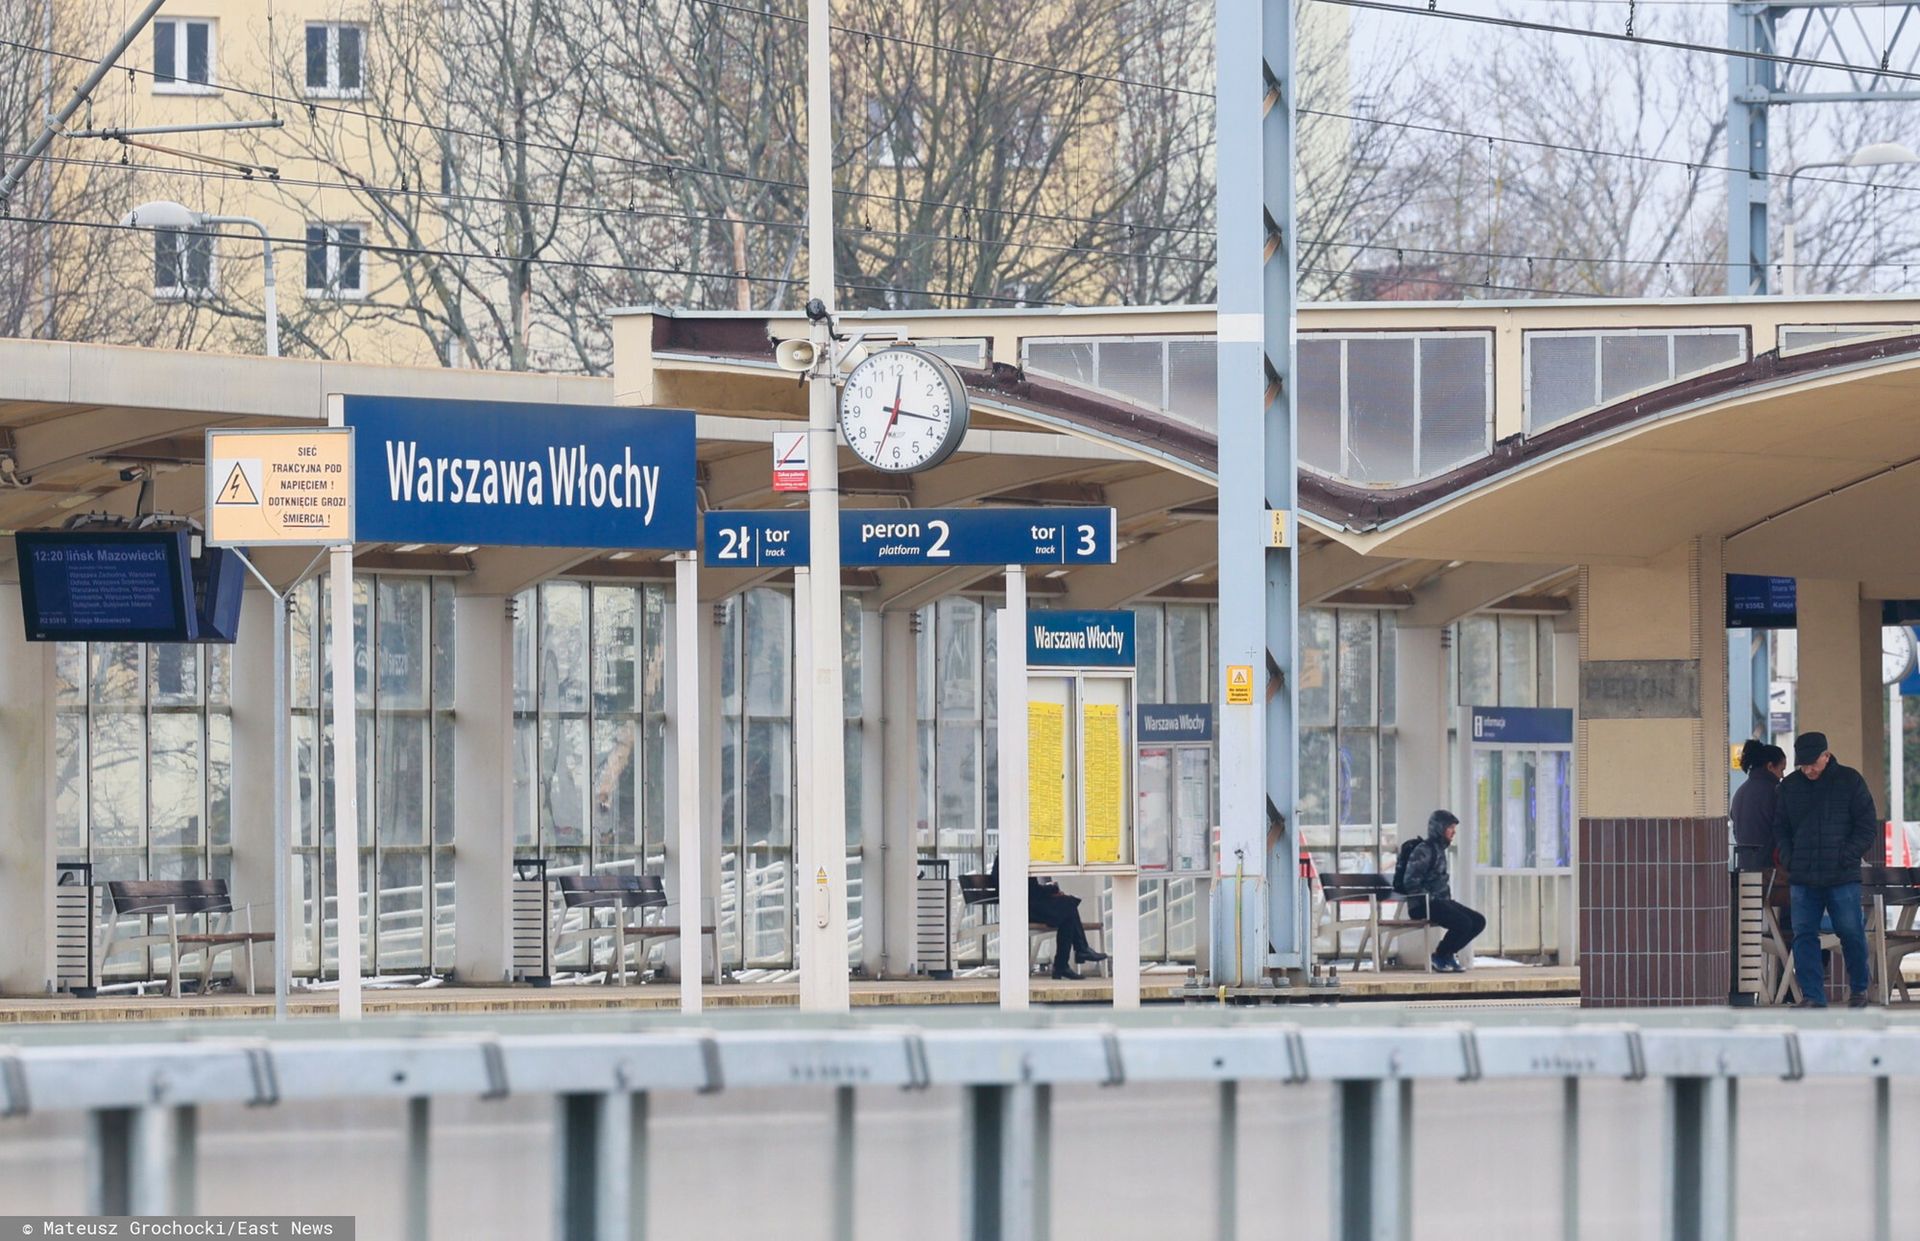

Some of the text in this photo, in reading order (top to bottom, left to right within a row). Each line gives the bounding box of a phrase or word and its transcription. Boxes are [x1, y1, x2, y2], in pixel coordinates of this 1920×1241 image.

[890, 364, 904, 376] 12
[873, 371, 884, 382] 11
[859, 386, 873, 398] 10
[926, 384, 934, 396] 2
[853, 406, 861, 417] 9
[932, 405, 940, 417] 3
[860, 426, 867, 439] 8
[926, 426, 934, 438] 4
[298, 445, 317, 456] SIEĆ
[874, 441, 882, 453] 7
[893, 447, 900, 459] 6
[912, 441, 920, 453] 5
[272, 463, 342, 473] TRAKCYJNA POD
[281, 480, 327, 491] NAPIĘCIEM
[386, 440, 660, 526] Warszawa Włochy
[268, 497, 346, 508] DOTKNIĘCIE GROZI
[718, 526, 790, 558] 2ł tor
[862, 520, 950, 558] peron 2
[1031, 525, 1096, 556] tor 3
[34, 551, 63, 560] 12:20
[98, 549, 165, 560] Mazowiecki
[765, 548, 786, 557] track
[878, 544, 920, 557] platform
[1035, 545, 1056, 554] track
[1034, 624, 1124, 655] Warszawa Włochy
[1144, 713, 1205, 734] Warszawa Włochy
